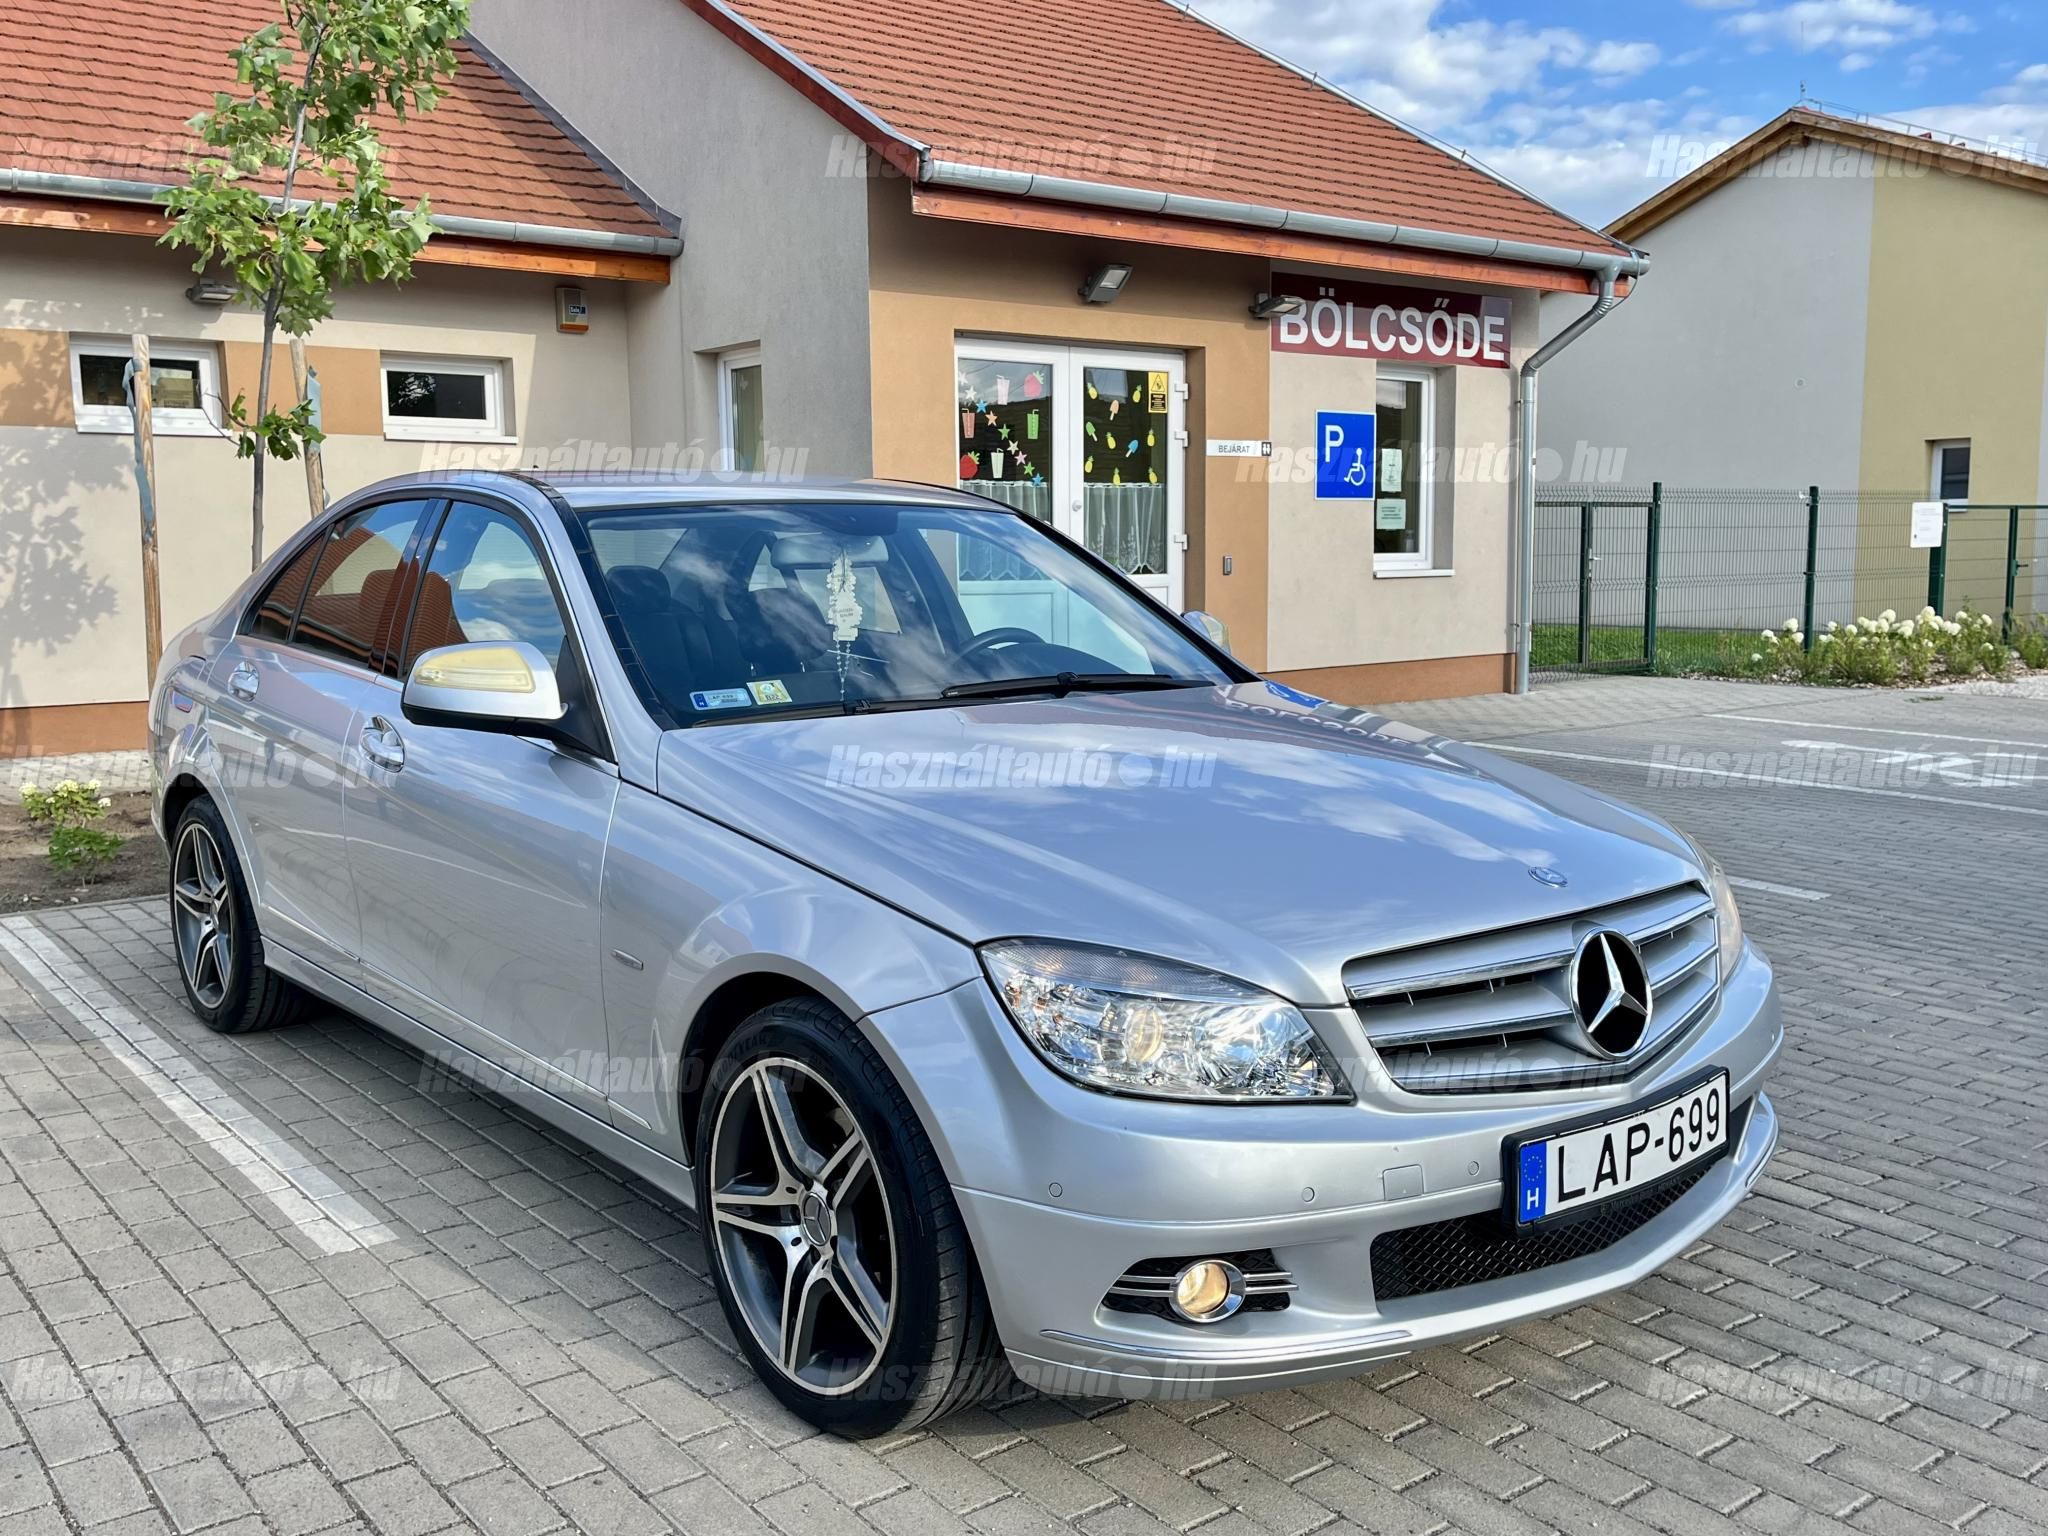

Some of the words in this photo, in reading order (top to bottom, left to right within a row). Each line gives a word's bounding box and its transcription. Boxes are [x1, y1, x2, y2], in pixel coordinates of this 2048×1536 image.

[1280, 287, 1504, 361] BÖLCSŐDE
[1217, 443, 1250, 453] BEJÁRAT
[1325, 425, 1344, 462] P
[1558, 1087, 1720, 1203] LAP-699
[1526, 1187, 1539, 1210] H
